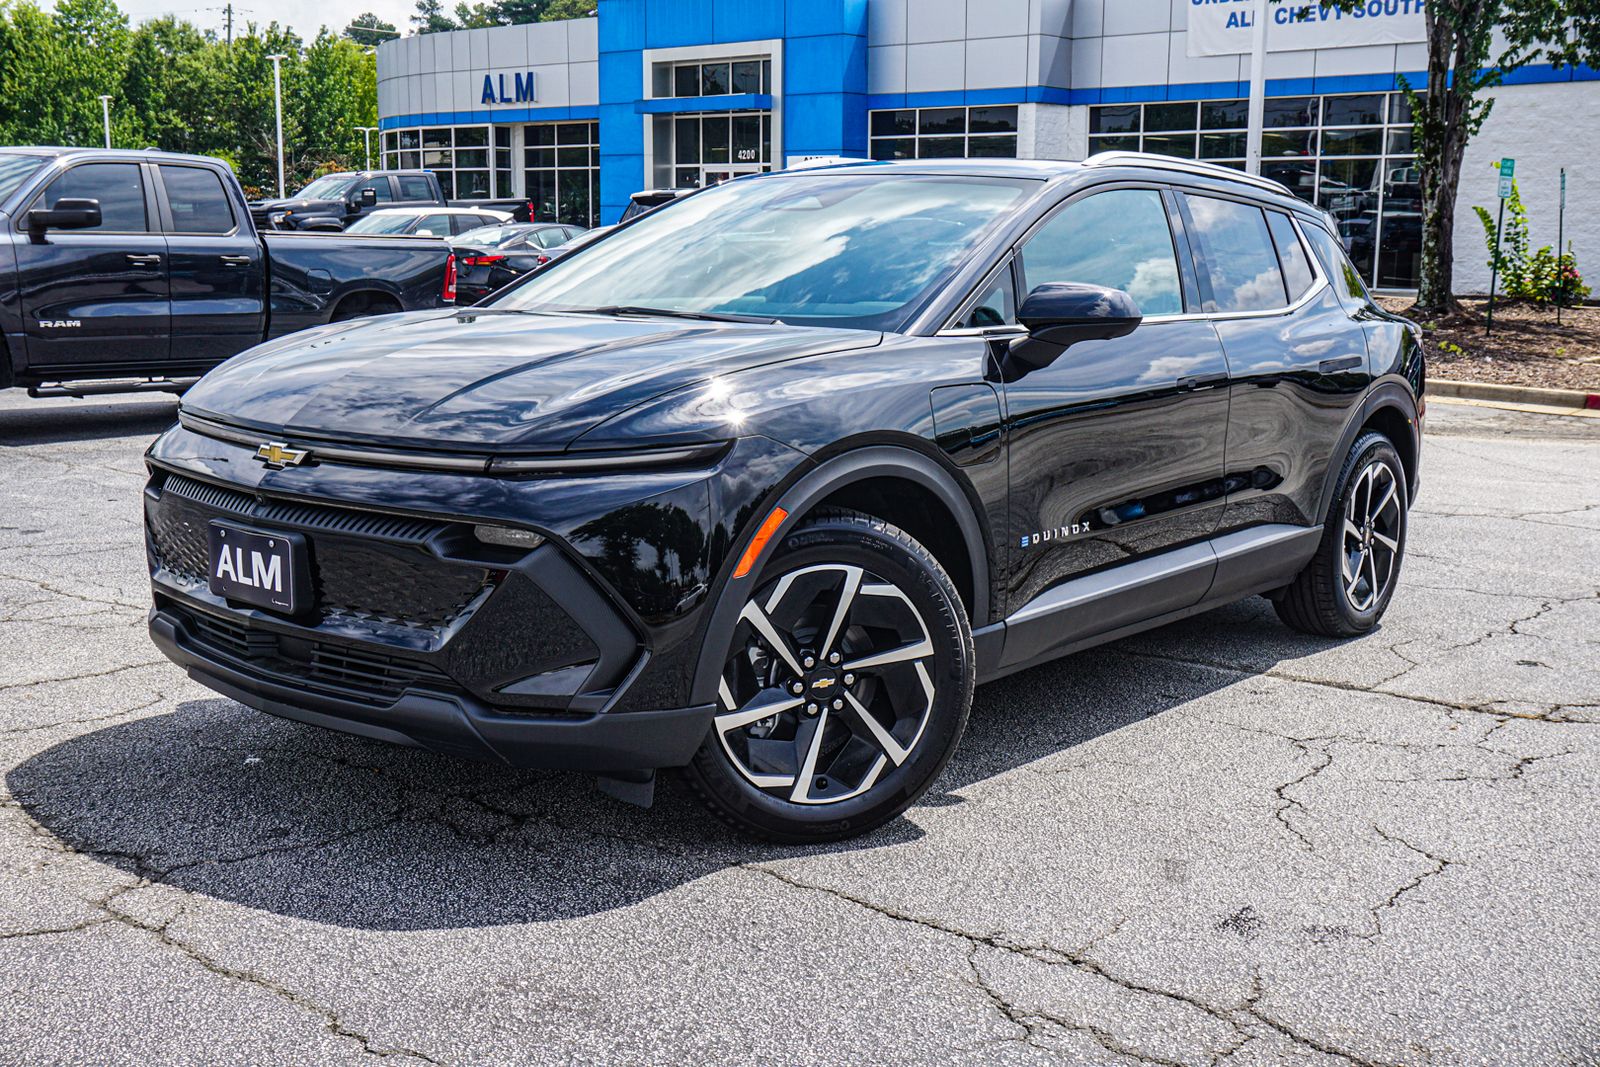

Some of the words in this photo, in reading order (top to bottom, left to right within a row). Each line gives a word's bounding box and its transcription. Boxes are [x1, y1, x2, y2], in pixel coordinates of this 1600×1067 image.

[1226, 10, 1255, 28] AL
[1275, 4, 1342, 24] CHEVY
[481, 71, 535, 104] ALM
[738, 149, 755, 160] 4200
[39, 320, 81, 328] RAM
[216, 543, 282, 593] ALM
